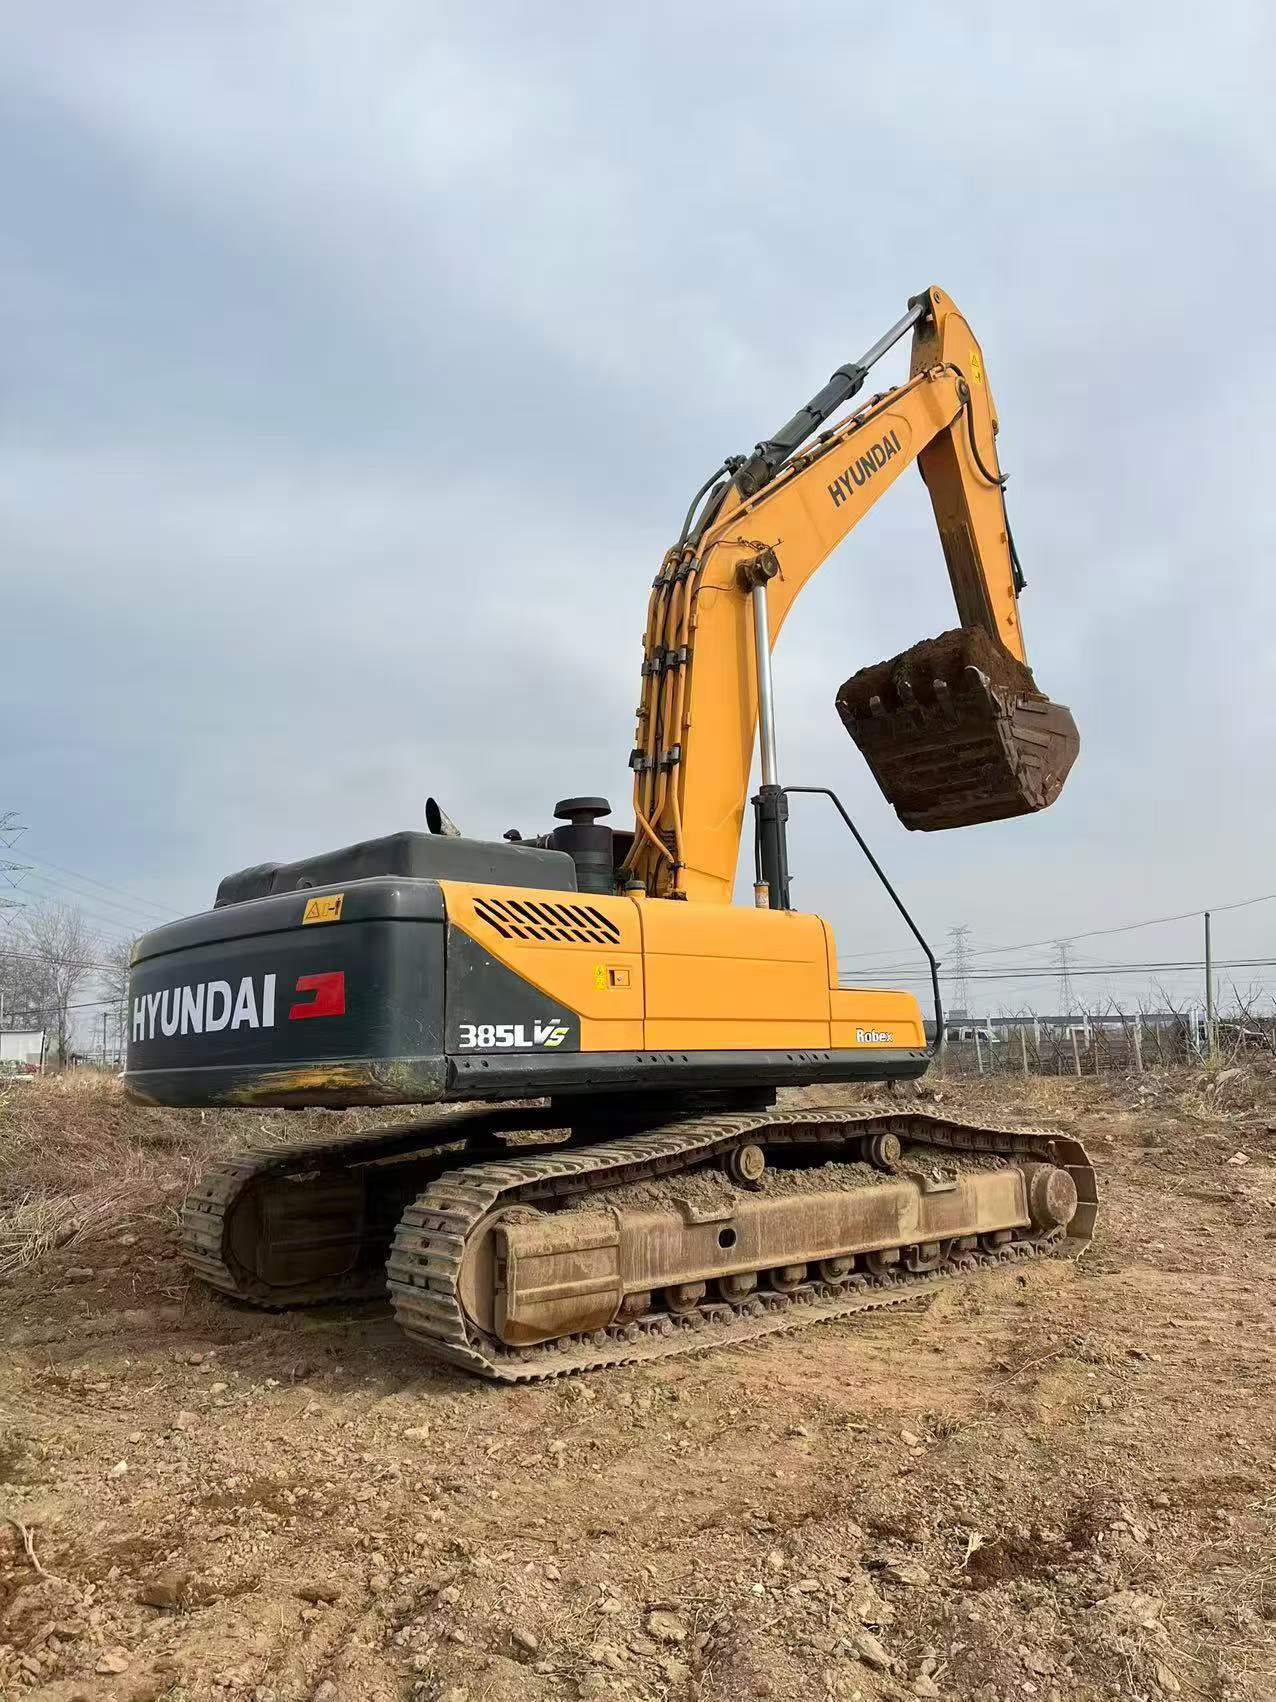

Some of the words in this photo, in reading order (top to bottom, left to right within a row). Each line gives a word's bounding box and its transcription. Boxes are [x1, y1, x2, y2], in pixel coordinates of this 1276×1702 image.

[827, 429, 902, 508] HYUNDAI
[132, 973, 277, 1043] HYUNDAI
[856, 1028, 893, 1043] Robex
